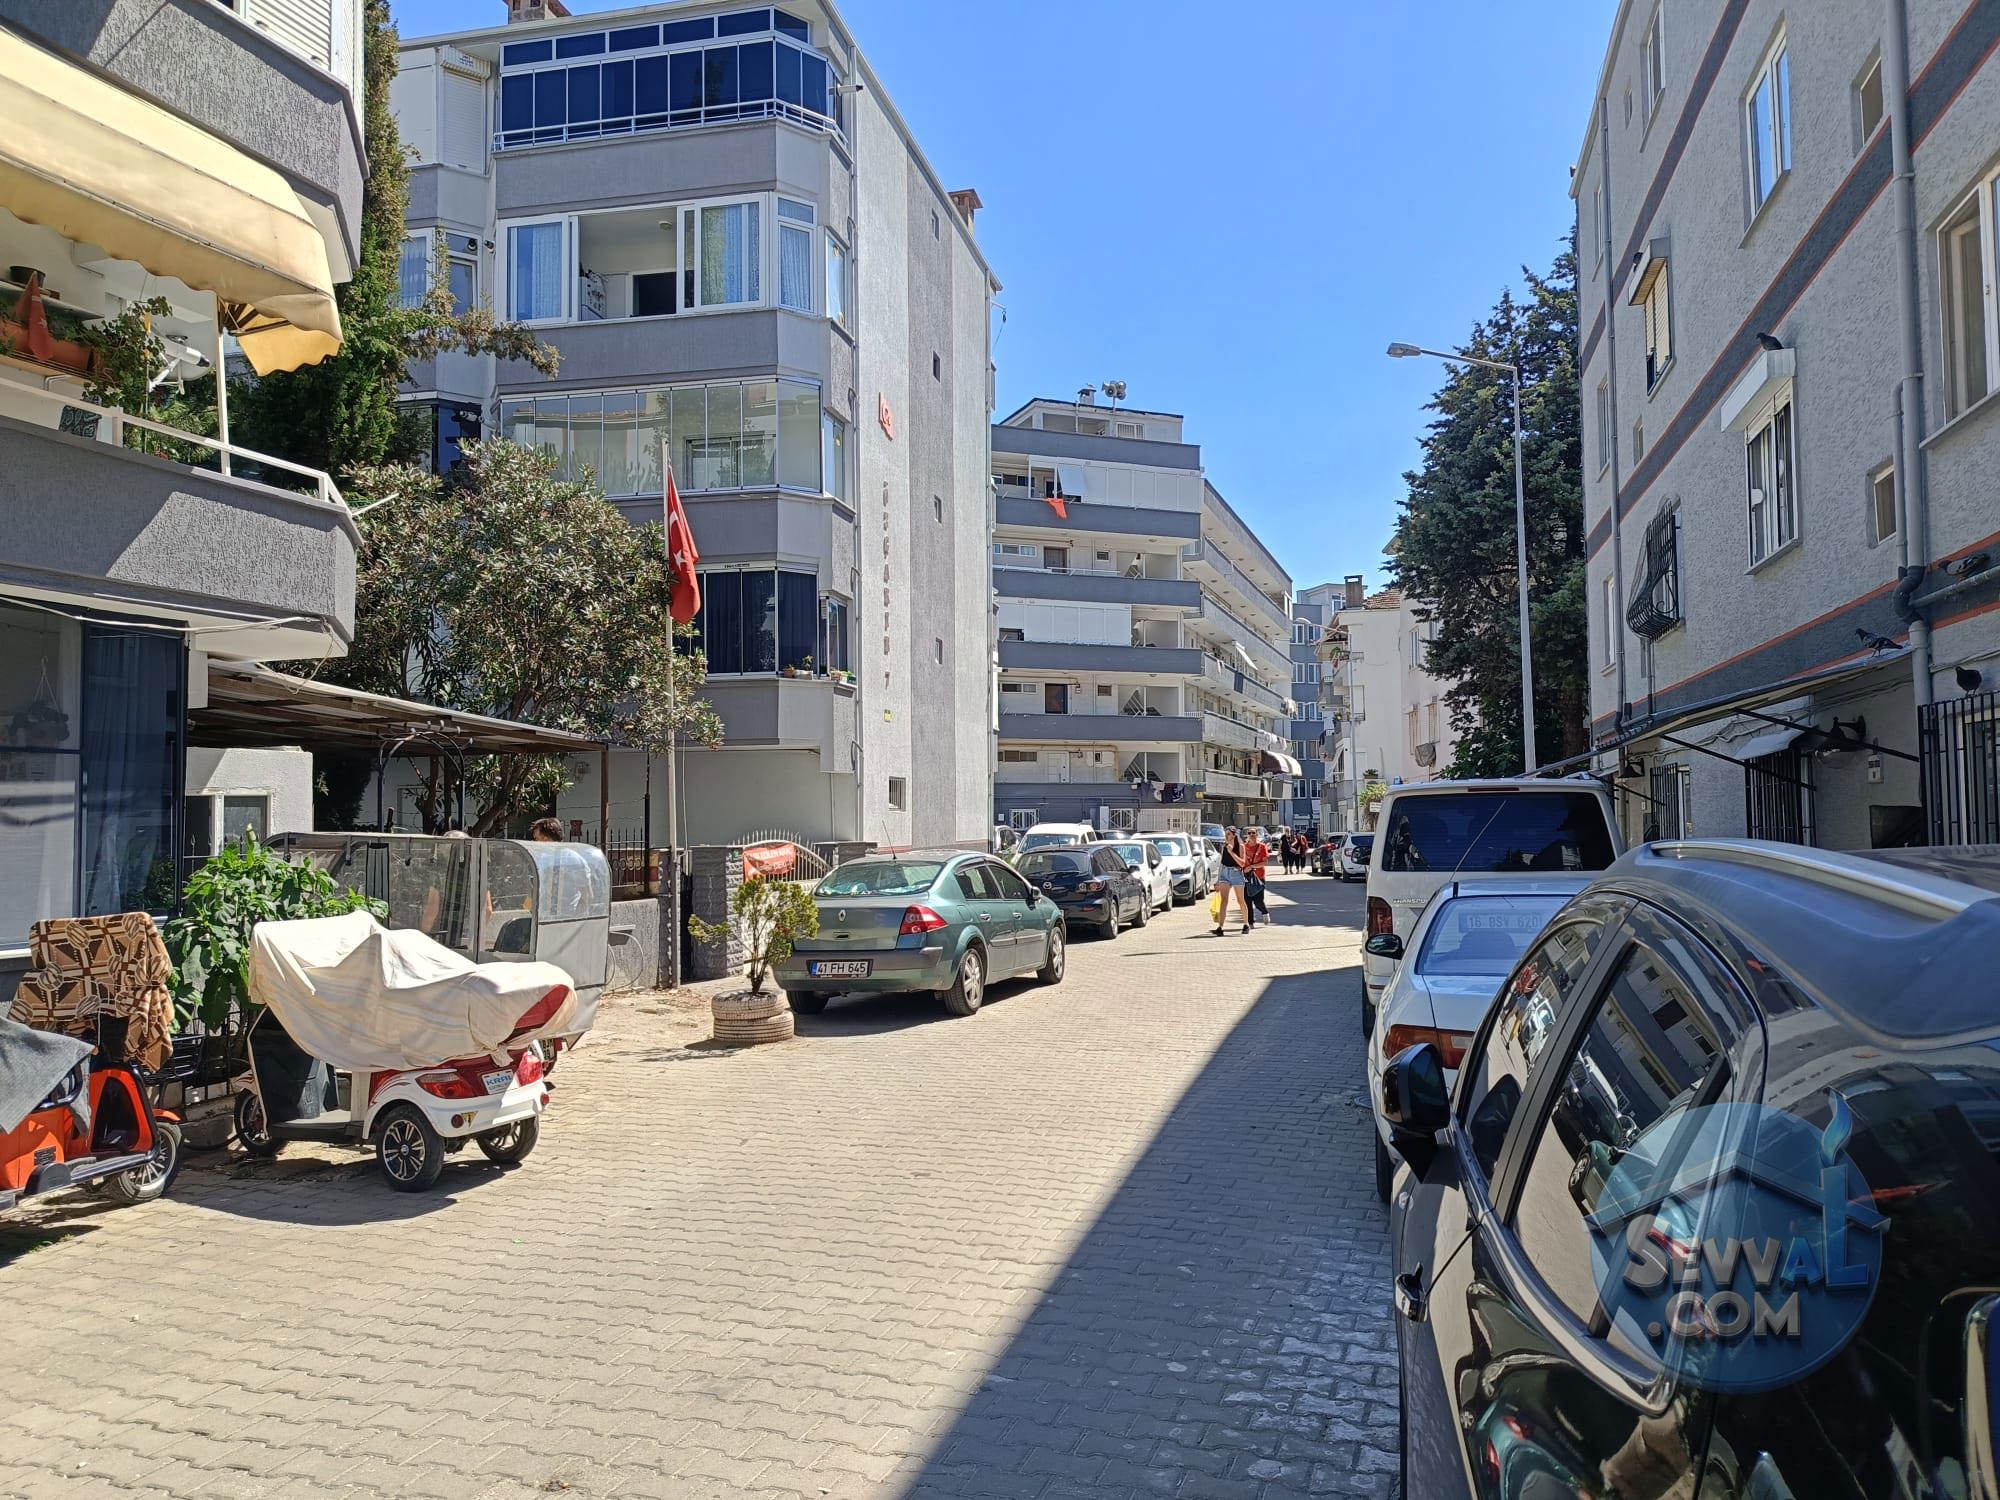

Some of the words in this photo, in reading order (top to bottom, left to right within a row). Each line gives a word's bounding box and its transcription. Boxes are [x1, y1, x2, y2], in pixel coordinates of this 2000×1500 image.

[1469, 916, 1482, 928] 16
[818, 963, 827, 973] 41
[830, 963, 845, 973] FH
[848, 963, 866, 973] 645
